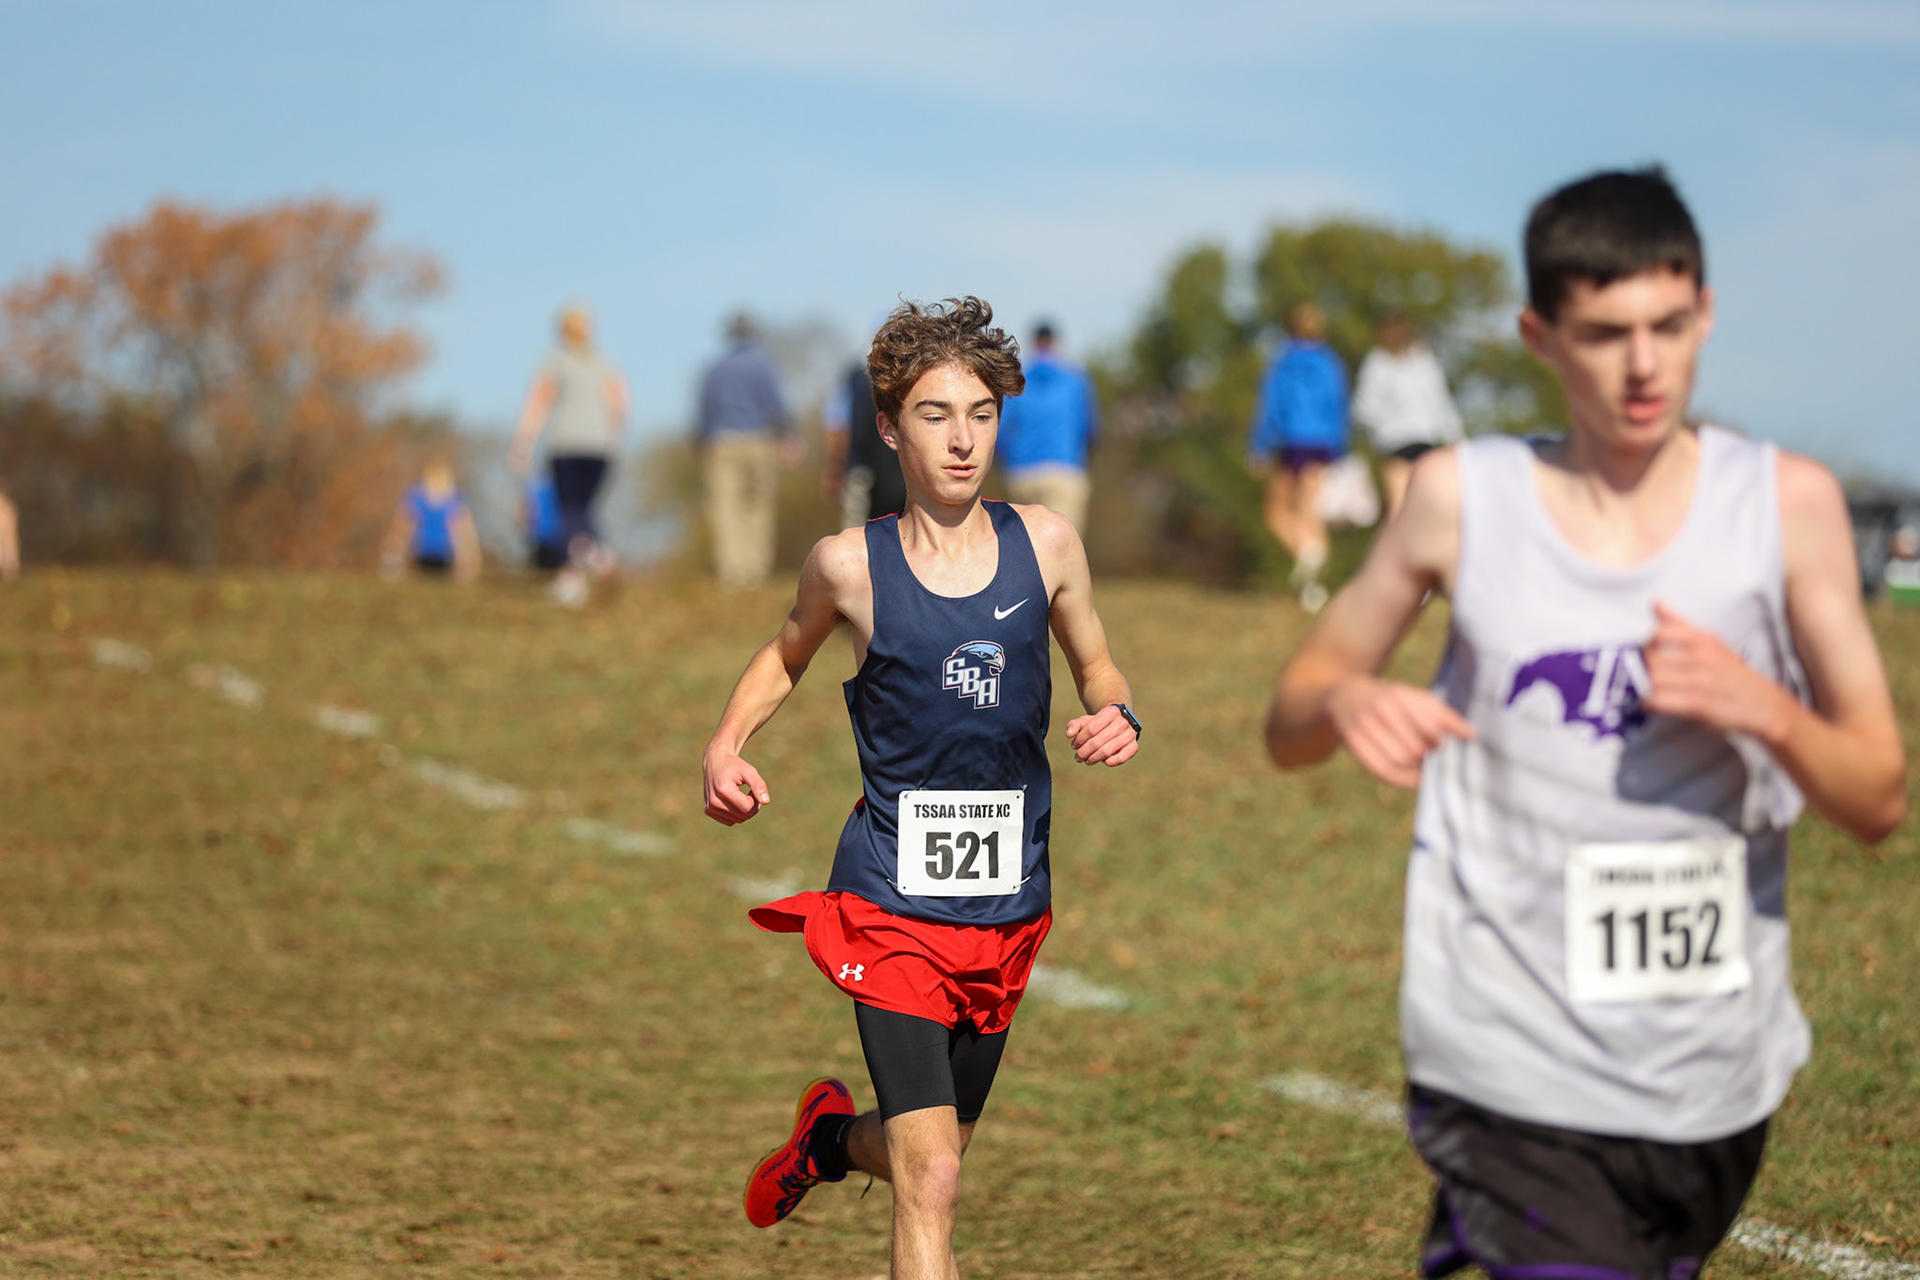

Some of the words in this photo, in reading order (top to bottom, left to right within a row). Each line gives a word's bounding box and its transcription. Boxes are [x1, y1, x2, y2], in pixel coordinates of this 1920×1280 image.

[945, 657, 998, 706] SBA
[913, 804, 957, 819] TSSAA
[959, 803, 994, 819] STATE
[996, 803, 1011, 818] XC
[925, 831, 999, 881] 521
[1594, 897, 1722, 971] 1152
